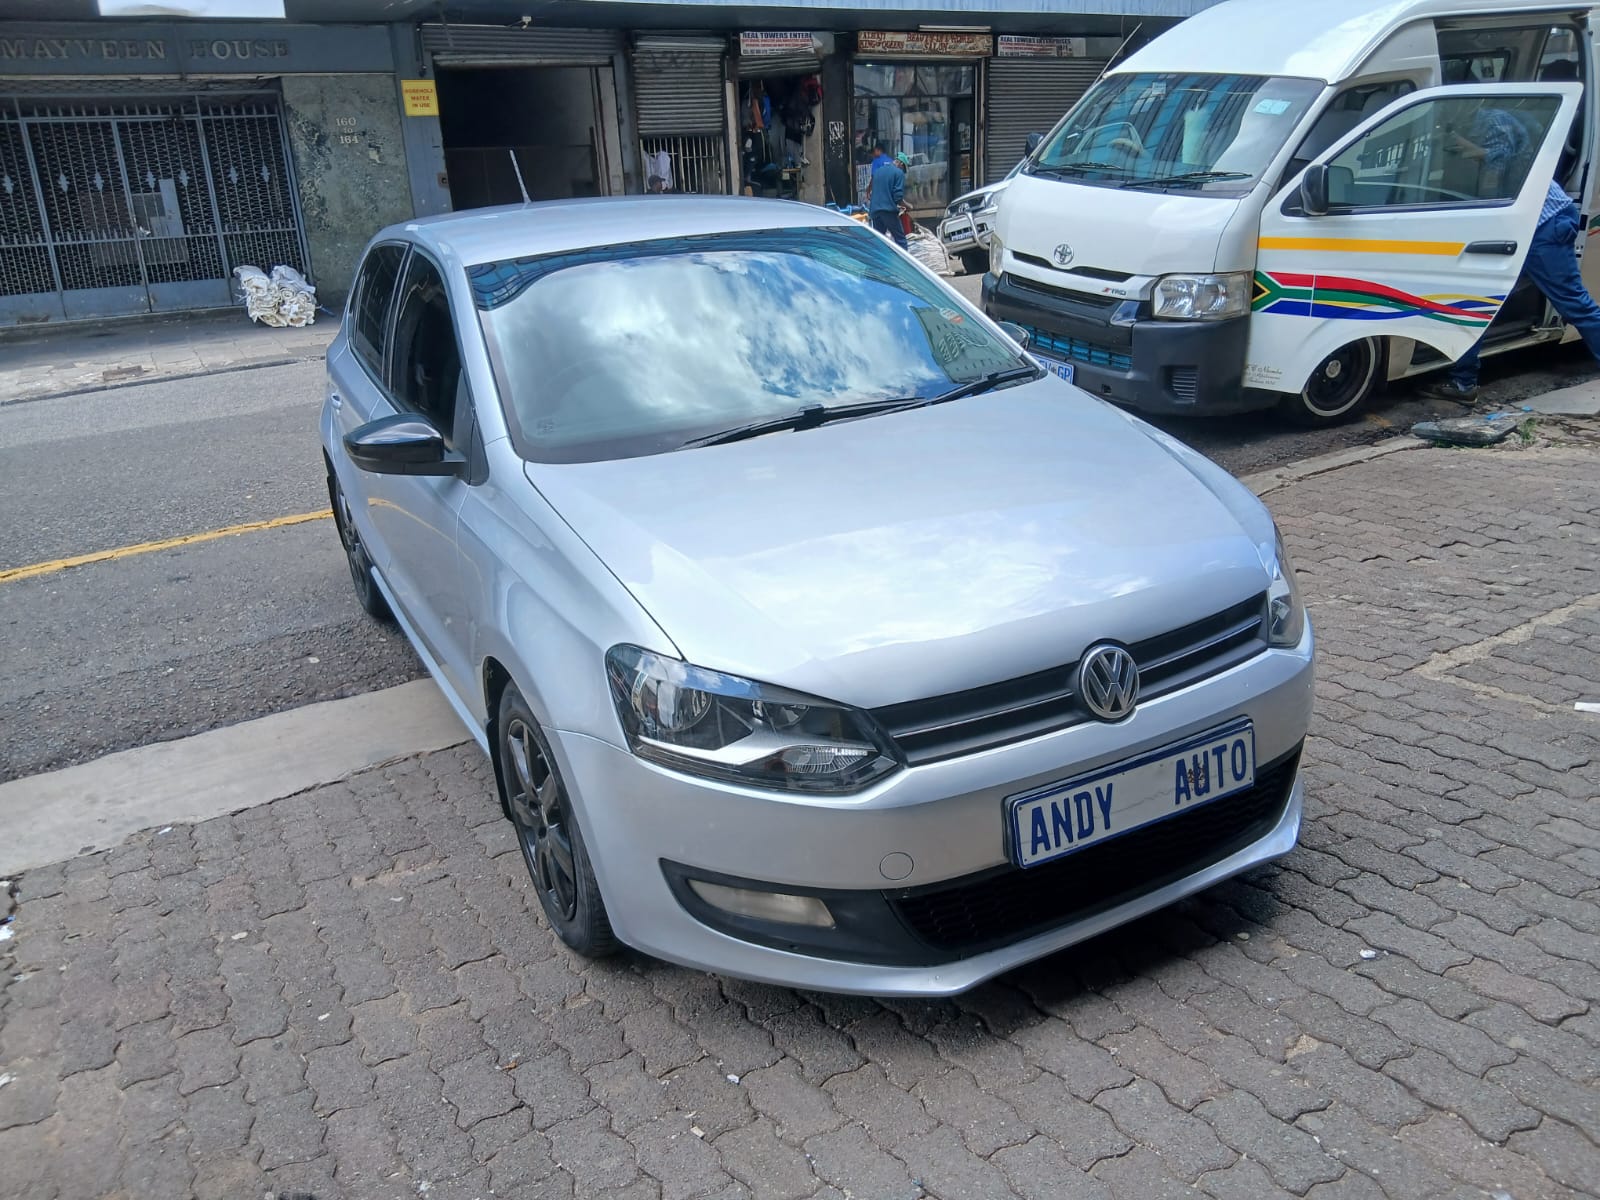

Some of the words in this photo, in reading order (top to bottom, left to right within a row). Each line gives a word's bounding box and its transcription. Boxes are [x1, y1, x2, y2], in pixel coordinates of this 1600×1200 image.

[1, 39, 167, 60] MAYVEEN
[191, 39, 289, 59] HOUSE
[335, 117, 357, 126] 160
[340, 135, 359, 144] 164
[1057, 365, 1070, 380] GP
[1031, 782, 1113, 855] ANDY
[1175, 738, 1247, 805] AUTO
